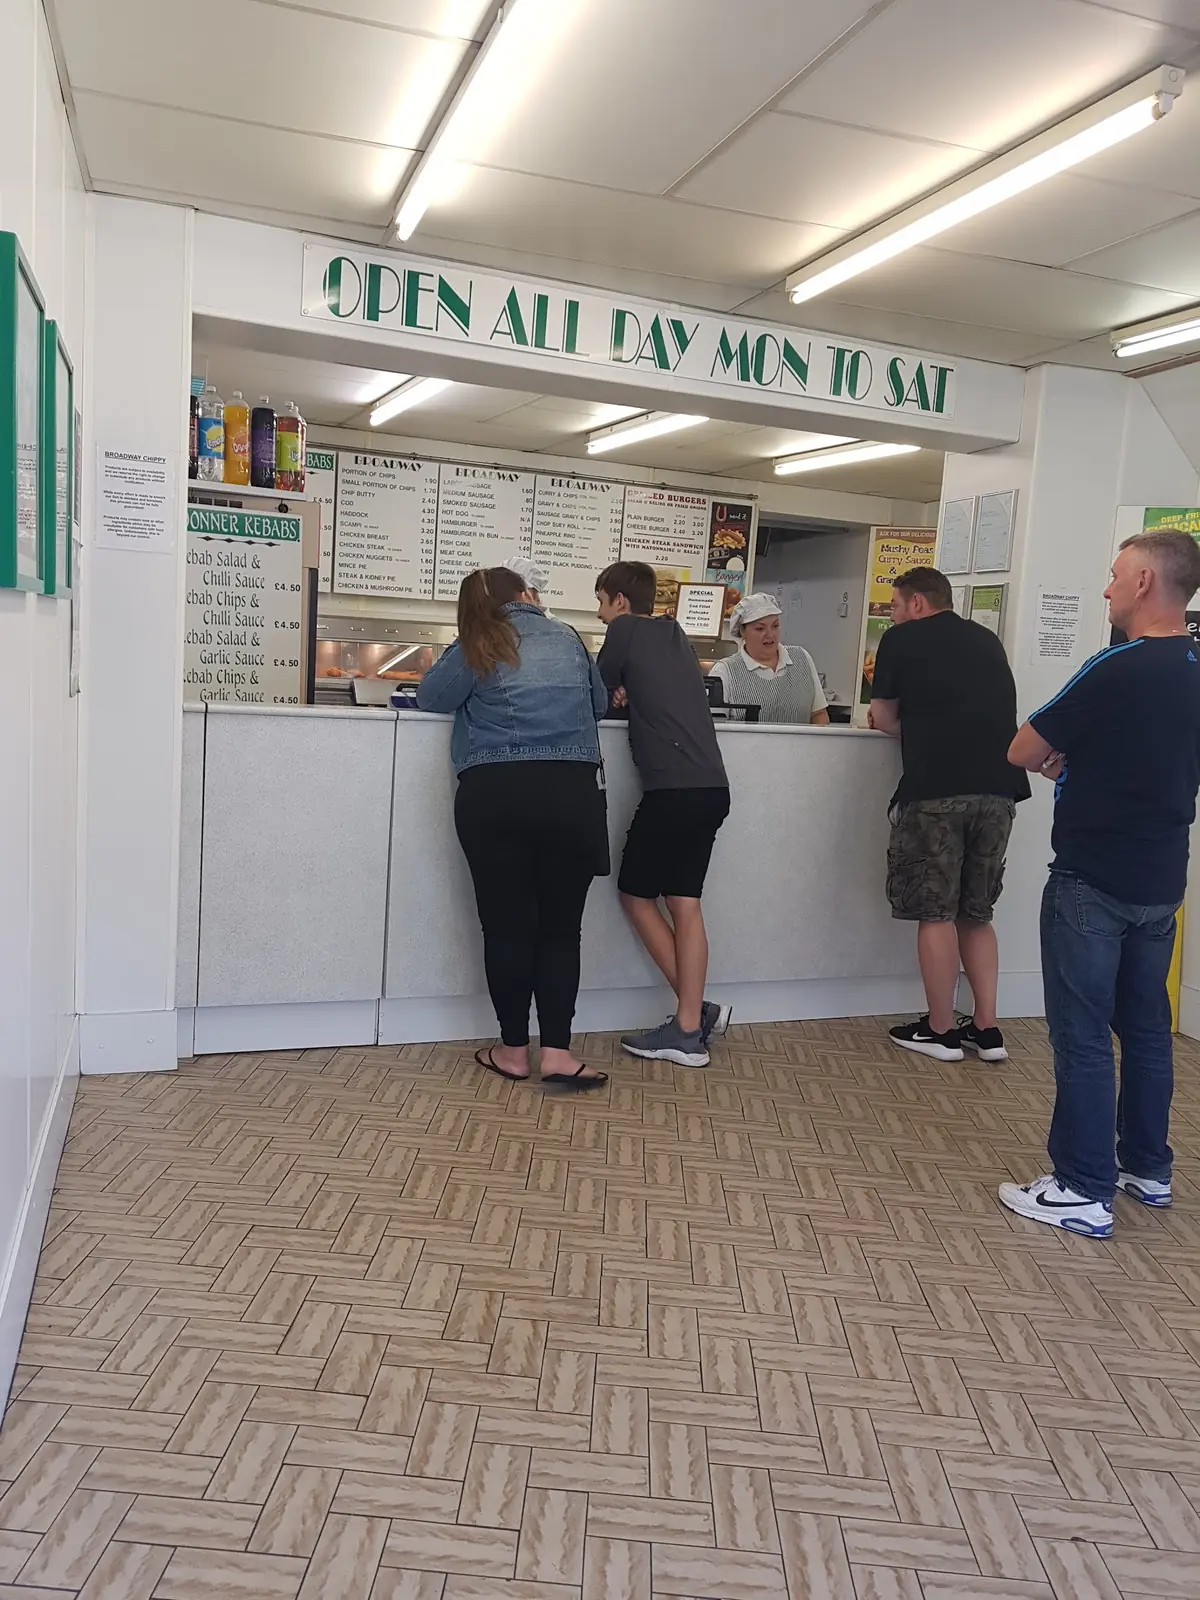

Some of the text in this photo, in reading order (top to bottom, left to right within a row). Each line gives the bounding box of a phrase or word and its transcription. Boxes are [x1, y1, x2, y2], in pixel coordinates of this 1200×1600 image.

[323, 256, 953, 413] OPEN ALL DAY MON TO SAT
[105, 451, 141, 461] BROADWAY
[307, 453, 332, 468] BABS
[354, 456, 423, 471] BROADWAY
[342, 468, 367, 476] PORTION
[456, 467, 521, 482] BROADWAY
[363, 481, 387, 489] PORTION
[551, 478, 612, 492] BROADWAY
[667, 493, 707, 505] BURGERS
[340, 510, 368, 518] HADDOCK
[1160, 515, 1183, 523] DEEP
[245, 516, 297, 539] KEBABS
[340, 531, 364, 539] CHICKEN
[673, 541, 704, 550] SANDWICH
[881, 544, 934, 555] Mushy Peas
[186, 549, 260, 569] ebab Salad &
[878, 555, 931, 566] Curry Sauce
[889, 566, 897, 575] &
[203, 571, 300, 591] Chilli Sauce £4.50
[186, 589, 259, 611] ebab Chips &
[203, 610, 299, 629] Chilli Sauce £4.50
[184, 629, 260, 646] ebab Salad &
[200, 650, 298, 667] Garlic Sauce £4.50
[184, 669, 259, 688] ebab Chips &
[200, 689, 231, 701] Garlic
[235, 689, 264, 703] Sauce
